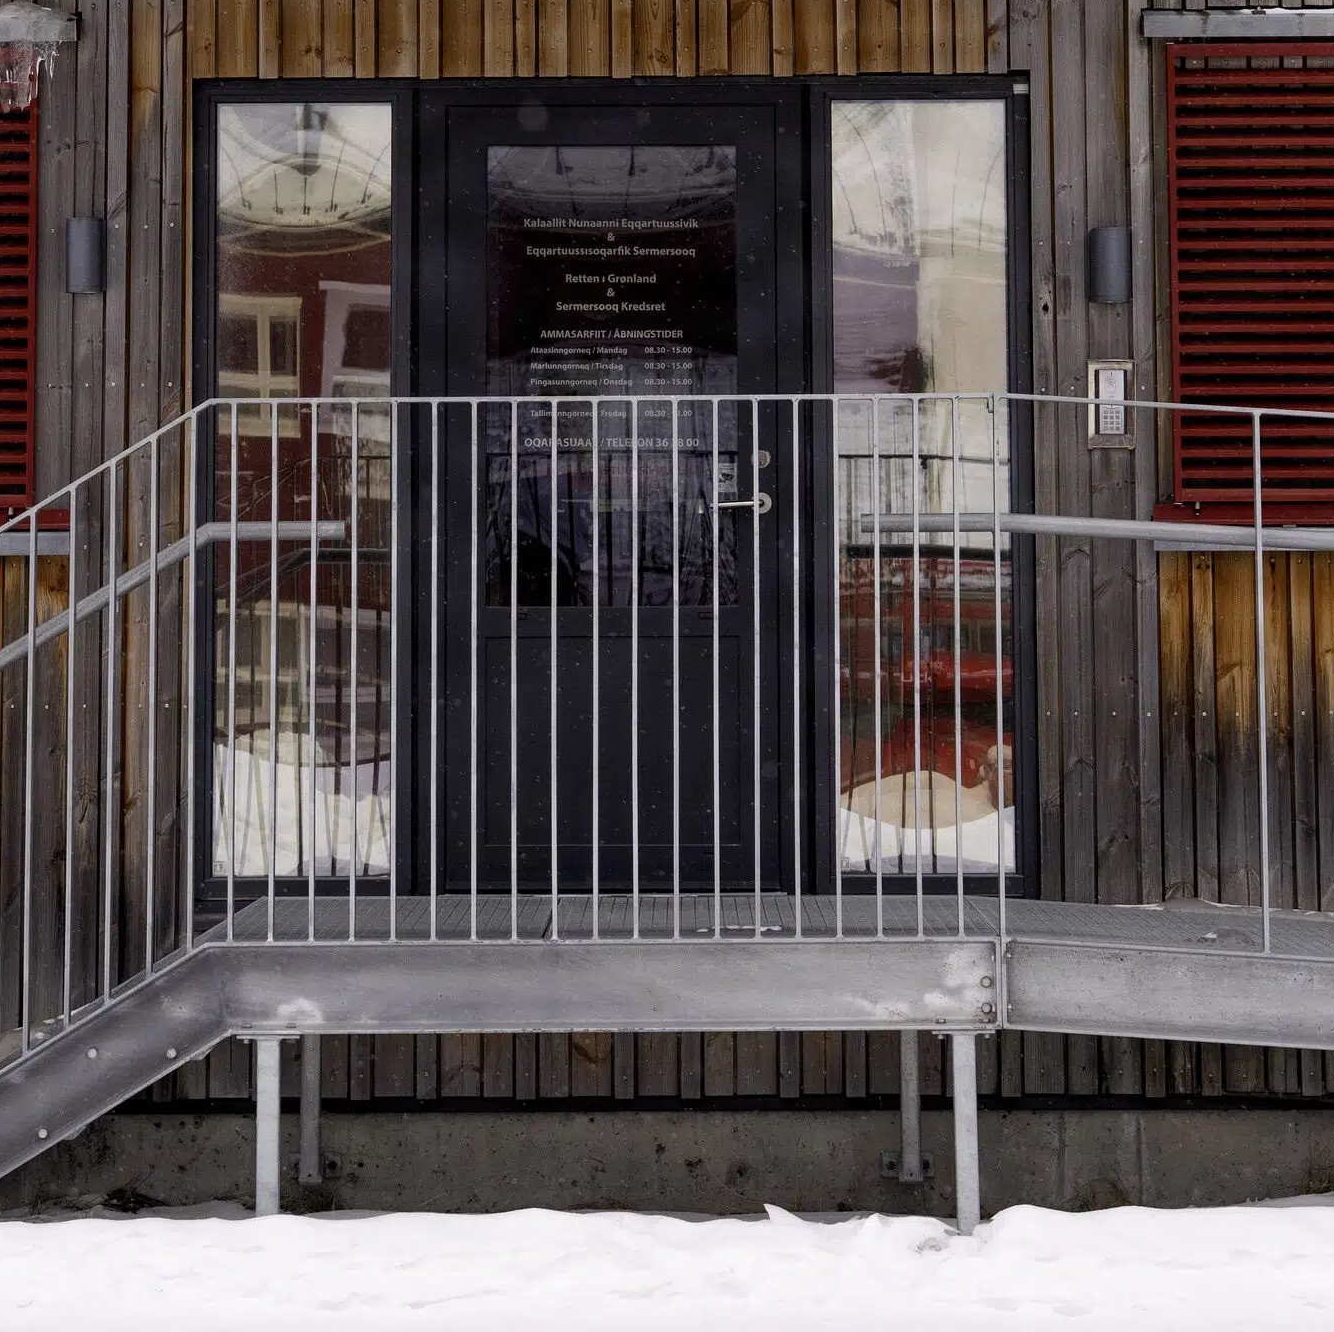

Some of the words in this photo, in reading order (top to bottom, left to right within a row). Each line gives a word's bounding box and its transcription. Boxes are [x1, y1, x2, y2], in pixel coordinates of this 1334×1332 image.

[523, 217, 567, 229] Kalaallit
[568, 217, 620, 229] Nunaanni
[621, 218, 699, 230] Eqqartuussivik
[606, 232, 616, 242] &
[526, 246, 631, 258] Eqqartuussisoqarfik
[633, 246, 696, 258] Sermersooq
[565, 273, 600, 284] Retten
[607, 273, 657, 284] Grønland
[606, 287, 616, 298] &
[556, 301, 619, 313] Sermersooq
[620, 300, 666, 312] Kredsret
[540, 329, 607, 339] AMMASARFIIT
[613, 327, 684, 340] ÅBNINGSTIDER
[530, 346, 591, 356] Ataasinngorneq
[597, 346, 628, 356] Mandag
[644, 346, 666, 355] 08.30
[672, 346, 693, 355] 15.00
[595, 361, 624, 372] Tirsdag
[644, 362, 666, 370] 08.30
[672, 362, 693, 370] 15.00
[603, 377, 634, 388] Onsdag
[530, 409, 596, 419] Tallimnngorneq
[672, 409, 693, 417] 2.00
[606, 437, 653, 447] TELEON
[655, 437, 669, 447] 36
[671, 437, 684, 447] 8
[686, 437, 700, 447] 00
